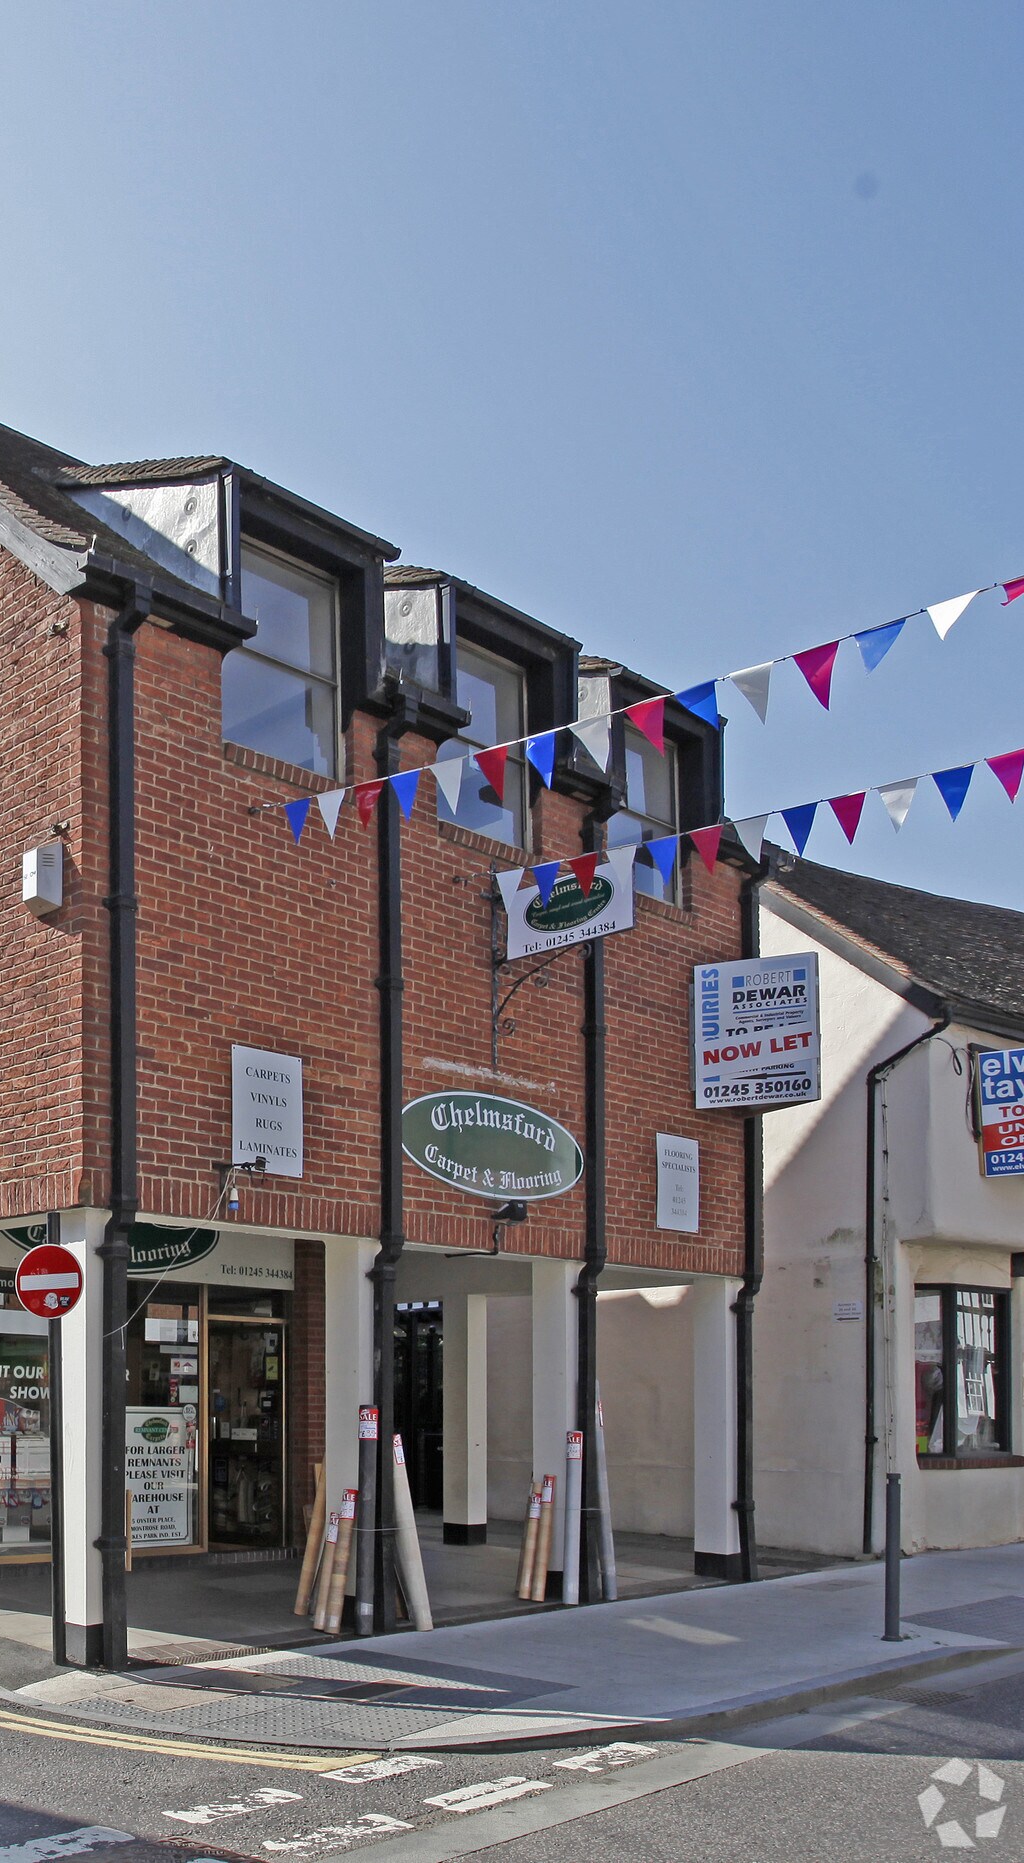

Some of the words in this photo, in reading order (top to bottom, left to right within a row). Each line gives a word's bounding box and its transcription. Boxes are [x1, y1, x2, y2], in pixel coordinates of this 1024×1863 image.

[532, 880, 603, 908] Celmsrd
[522, 943, 542, 954] Tel:
[546, 932, 575, 947] 01245
[579, 920, 617, 939] 344384
[745, 970, 791, 987] ROBERT
[732, 984, 806, 1004] DEWAR
[733, 997, 808, 1010] ASSOCIATES
[703, 1041, 762, 1065] NOW
[770, 1032, 813, 1053] LET
[245, 1066, 291, 1084] CARPETS
[703, 1084, 750, 1099] 01245
[755, 1078, 812, 1094] 350160
[250, 1092, 287, 1108] VINYLS
[709, 1091, 807, 1104] www.robertdewar.co.uk
[255, 1117, 283, 1132] RUGS
[430, 1100, 556, 1152] Chelmsford
[239, 1140, 298, 1158] LAMINATES
[664, 1148, 693, 1160] FLOORING
[424, 1143, 478, 1183] Carpet
[482, 1167, 495, 1188] &
[498, 1169, 562, 1190] Flooring
[661, 1160, 696, 1174] SPECIALISTS
[130, 1240, 193, 1263] looring
[221, 1264, 237, 1275] Tel:
[239, 1266, 263, 1277] 01245
[265, 1267, 293, 1280] 344384
[13, 1365, 44, 1379] OUR
[125, 1446, 144, 1455] FOR
[147, 1445, 185, 1454] LARGER
[128, 1458, 181, 1467] REMNANTS
[161, 1469, 185, 1479] VISIT
[144, 1481, 164, 1490] OUR
[131, 1493, 184, 1502] AREHOUSE
[147, 1505, 160, 1514] AT
